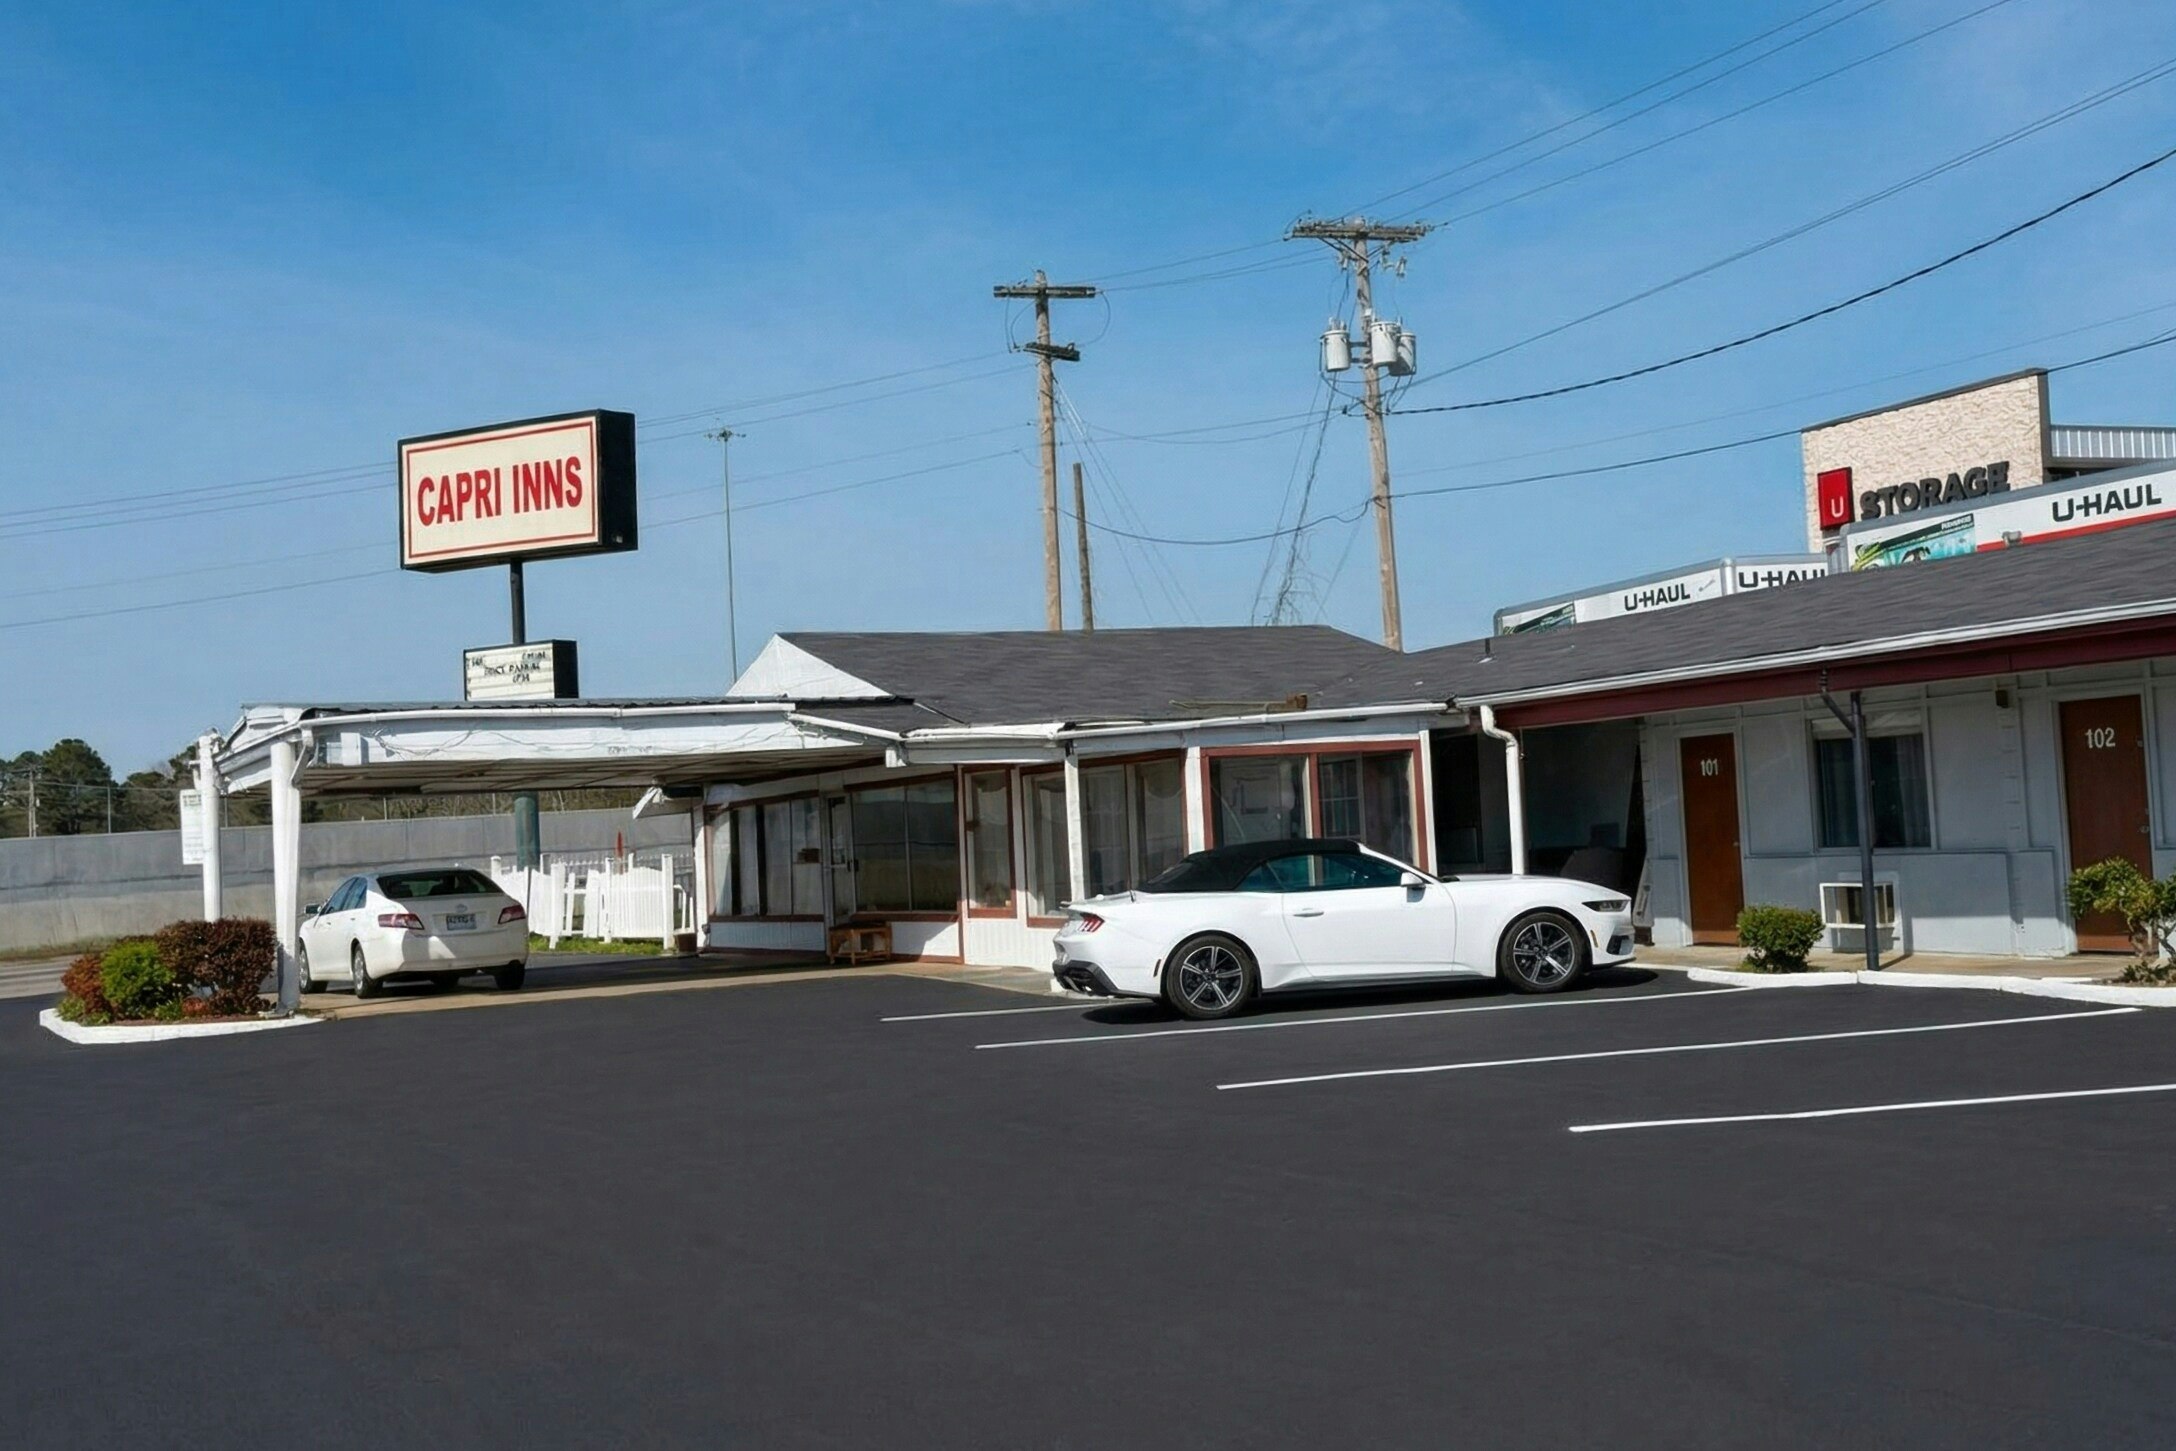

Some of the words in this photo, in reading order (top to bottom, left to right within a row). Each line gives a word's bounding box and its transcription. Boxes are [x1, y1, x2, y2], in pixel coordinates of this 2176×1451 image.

[417, 467, 502, 526] CAPRI
[513, 456, 583, 514] INNS
[1831, 496, 1844, 518] U
[1860, 461, 2010, 520] STORAGE
[2052, 484, 2162, 522] U-HAUL
[1624, 583, 1691, 611] U-HAUL
[2085, 727, 2116, 748] 102
[1700, 758, 1718, 776] 101
